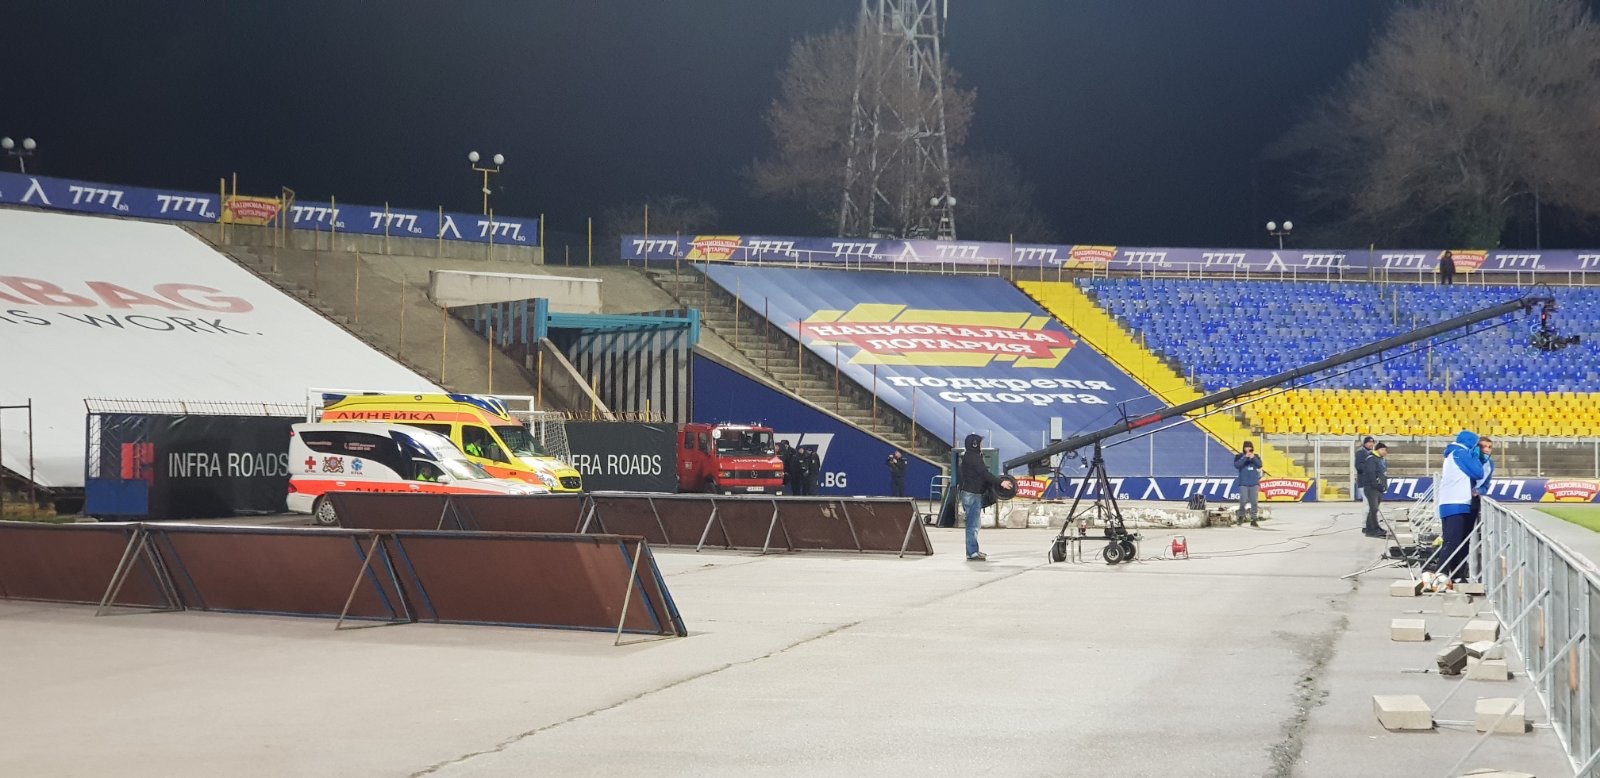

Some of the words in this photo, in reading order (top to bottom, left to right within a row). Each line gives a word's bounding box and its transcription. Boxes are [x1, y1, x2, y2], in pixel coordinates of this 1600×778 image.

[58, 311, 263, 336] WORK.
[808, 325, 1058, 344] НАЦИОНАЛНА
[866, 338, 1037, 354] ЛОТАРИЯ
[886, 376, 1117, 392] подкрепя
[939, 391, 1109, 406] спорта
[337, 411, 436, 421] ЛИНЕЙКА
[168, 452, 222, 477] INFRA
[228, 452, 289, 477] ROADS
[608, 454, 662, 475] ROADS
[1260, 479, 1306, 489] НАЦИОНАЛНА
[1548, 481, 1597, 491] НАЦИОНАЛНА
[1267, 488, 1299, 497] ЛОТАРИЯ
[1555, 489, 1589, 498] ЛОТАРИЯ
